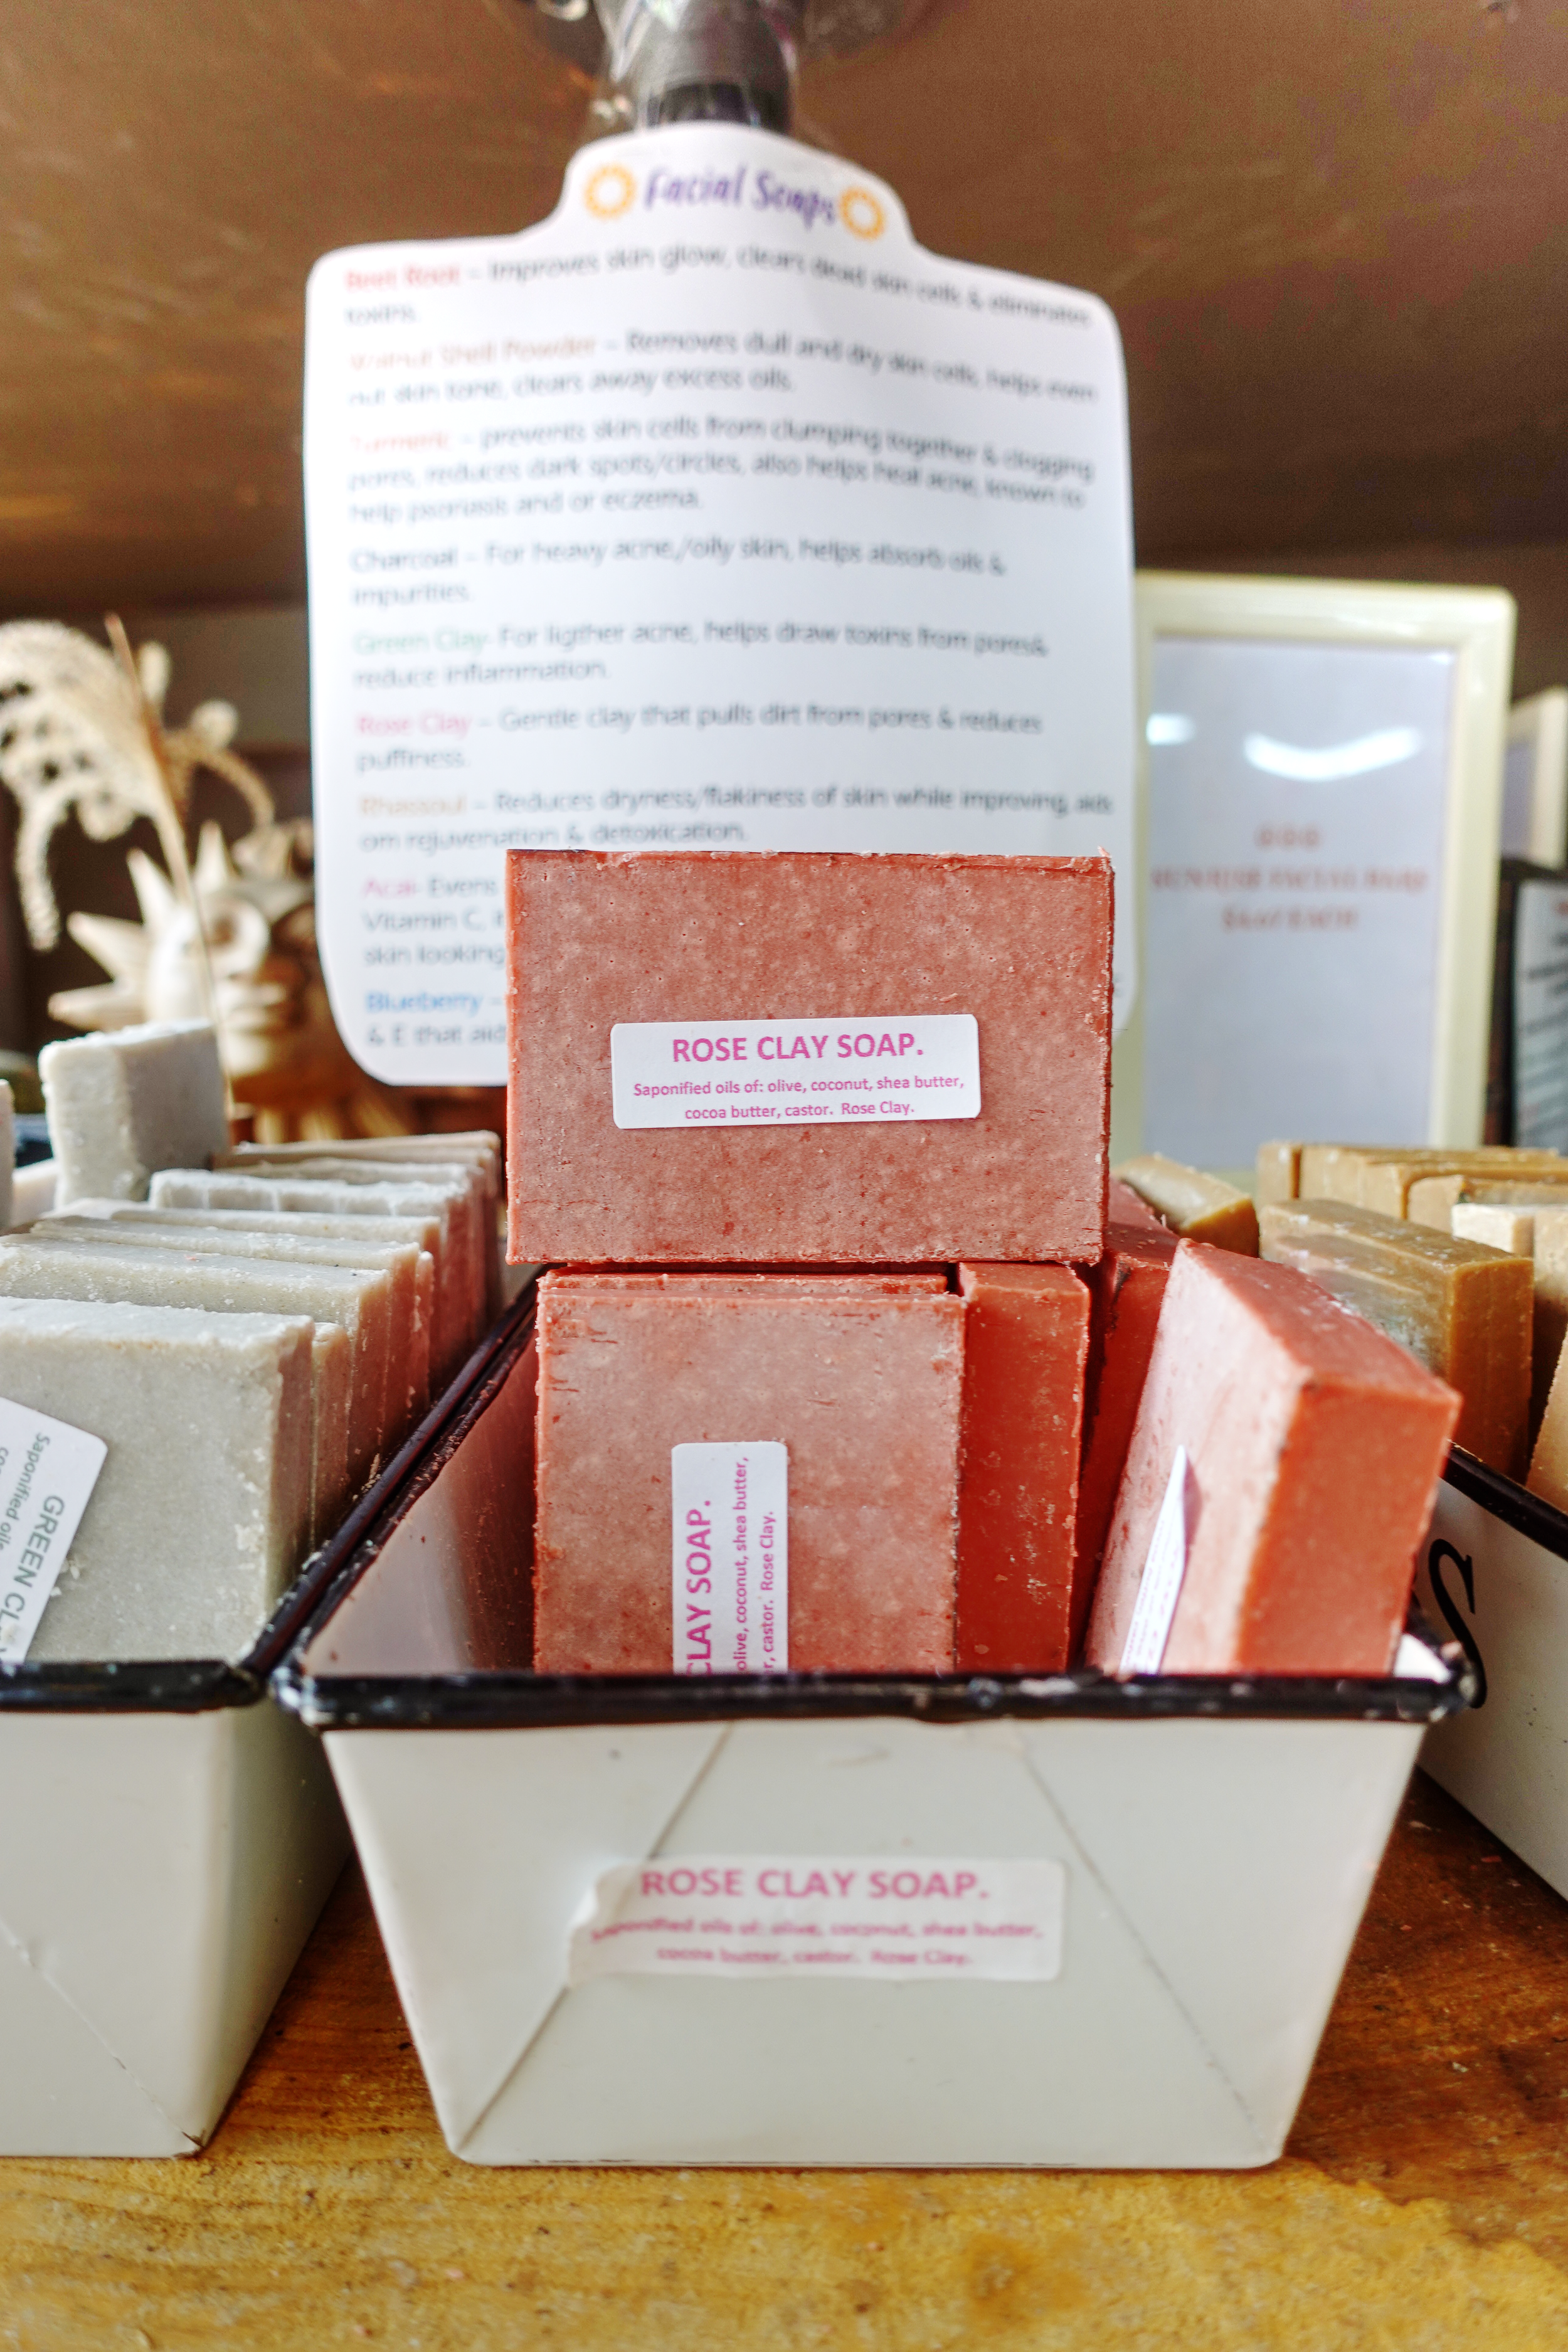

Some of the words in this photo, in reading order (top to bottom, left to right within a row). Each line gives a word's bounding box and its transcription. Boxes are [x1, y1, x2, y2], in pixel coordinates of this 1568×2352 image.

[645, 164, 747, 210] Facial
[753, 169, 837, 227] Soaps
[489, 253, 600, 283] Improves
[607, 245, 654, 270] skin
[660, 244, 730, 273] glow,
[736, 244, 803, 275] clears
[625, 331, 737, 354] Removes
[744, 332, 791, 354] dull
[796, 338, 841, 363] and
[846, 344, 882, 373] dry
[889, 351, 926, 374] skin
[393, 382, 440, 402] skin
[513, 372, 583, 399] clears
[590, 370, 657, 395] away
[662, 368, 743, 390] excess
[480, 420, 587, 452] prevents
[593, 415, 640, 438] skin
[647, 415, 700, 437] cells
[705, 415, 765, 440] from
[771, 419, 880, 453] clumping
[886, 428, 977, 460] together
[425, 460, 519, 485] reduces
[527, 453, 580, 477] dark
[753, 452, 802, 474] also
[807, 457, 868, 486] helps
[874, 461, 919, 484] heal
[985, 475, 1055, 503] known
[515, 492, 564, 514] and
[569, 492, 595, 512] or
[349, 547, 457, 573] Charcoal
[485, 544, 525, 565] For
[532, 542, 608, 567] heavy
[799, 539, 861, 569] helps
[867, 543, 944, 569] absorb
[948, 553, 983, 573] oils
[352, 630, 428, 655] Green
[497, 626, 537, 647] For
[705, 621, 770, 647] helps
[776, 621, 841, 644] draw
[844, 625, 911, 649] toxins
[916, 625, 968, 649] from
[352, 665, 437, 690] reduce
[357, 713, 412, 737] Rose
[418, 710, 472, 740] Clay
[499, 709, 580, 732] Gentle
[585, 707, 637, 733] clay
[642, 705, 690, 725] that
[696, 700, 755, 729] pulls
[760, 702, 802, 726] dirt
[807, 702, 861, 726] from
[867, 709, 930, 733] pores
[959, 712, 1043, 734] reduces
[494, 792, 593, 813] Reduces
[812, 784, 837, 808] of
[844, 784, 888, 808] skin
[894, 786, 952, 808] while
[407, 825, 559, 852] rejuvenation
[567, 825, 583, 845] &
[361, 911, 457, 931] Vitamin
[365, 945, 410, 966] skin
[365, 991, 483, 1017] Blueberry
[414, 1025, 462, 1046] that
[672, 1037, 746, 1062] ROSE
[757, 1036, 828, 1061] CLAY
[837, 1033, 923, 1059] SOAP.
[633, 1081, 711, 1097] Saponified
[716, 1080, 740, 1094] oils
[744, 1079, 763, 1093] of:
[768, 1078, 806, 1094] olive,
[811, 1078, 872, 1092] coconut,
[877, 1076, 909, 1089] shea
[914, 1075, 963, 1089] butter,
[685, 1108, 726, 1119] cocoa
[731, 1105, 780, 1120] butter,
[785, 1104, 834, 1116] castor.
[841, 1103, 875, 1115] Rose
[879, 1101, 914, 1116] Clay.
[6, 1433, 50, 1520] Saponified
[733, 1457, 749, 1510] butter,
[14, 1495, 65, 1587] GREEN
[686, 1500, 711, 1593] SOAP.
[733, 1515, 746, 1551] shea
[760, 1511, 776, 1550] Clay.
[734, 1556, 749, 1623] coconut,
[760, 1554, 774, 1591] Rose
[762, 1600, 774, 1652] castor.
[733, 1628, 749, 1671] olive,
[640, 1869, 744, 1897] ROSE
[757, 1870, 857, 1898] CLAY
[868, 1872, 989, 1899] SOAP.
